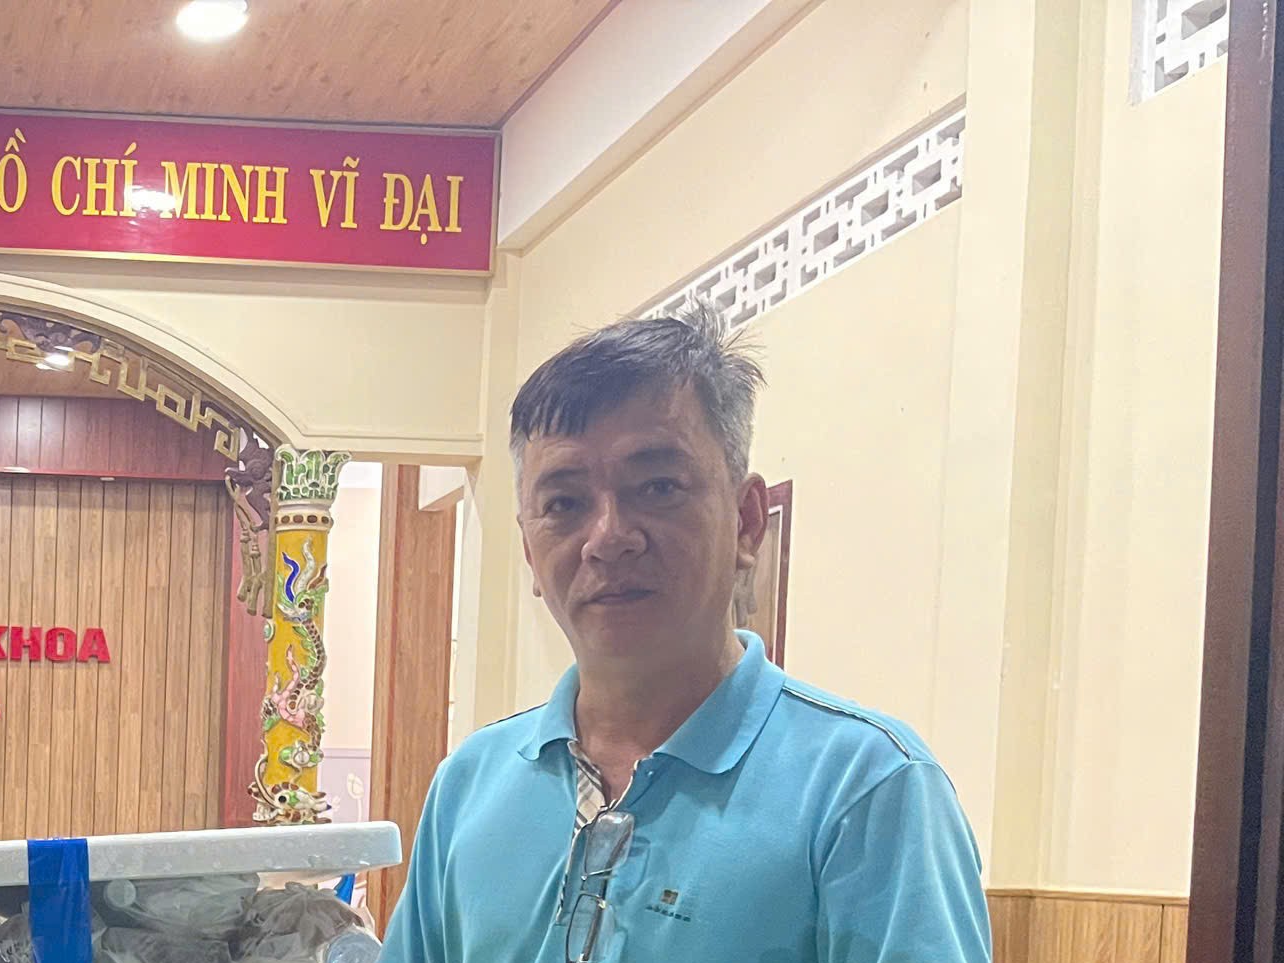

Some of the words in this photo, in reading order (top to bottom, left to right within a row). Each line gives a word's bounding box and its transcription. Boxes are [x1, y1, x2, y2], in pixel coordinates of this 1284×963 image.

[52, 142, 137, 217] CHÍ
[160, 161, 288, 225] MINH
[310, 157, 359, 229] VĨ
[380, 173, 463, 245] ĐẠI
